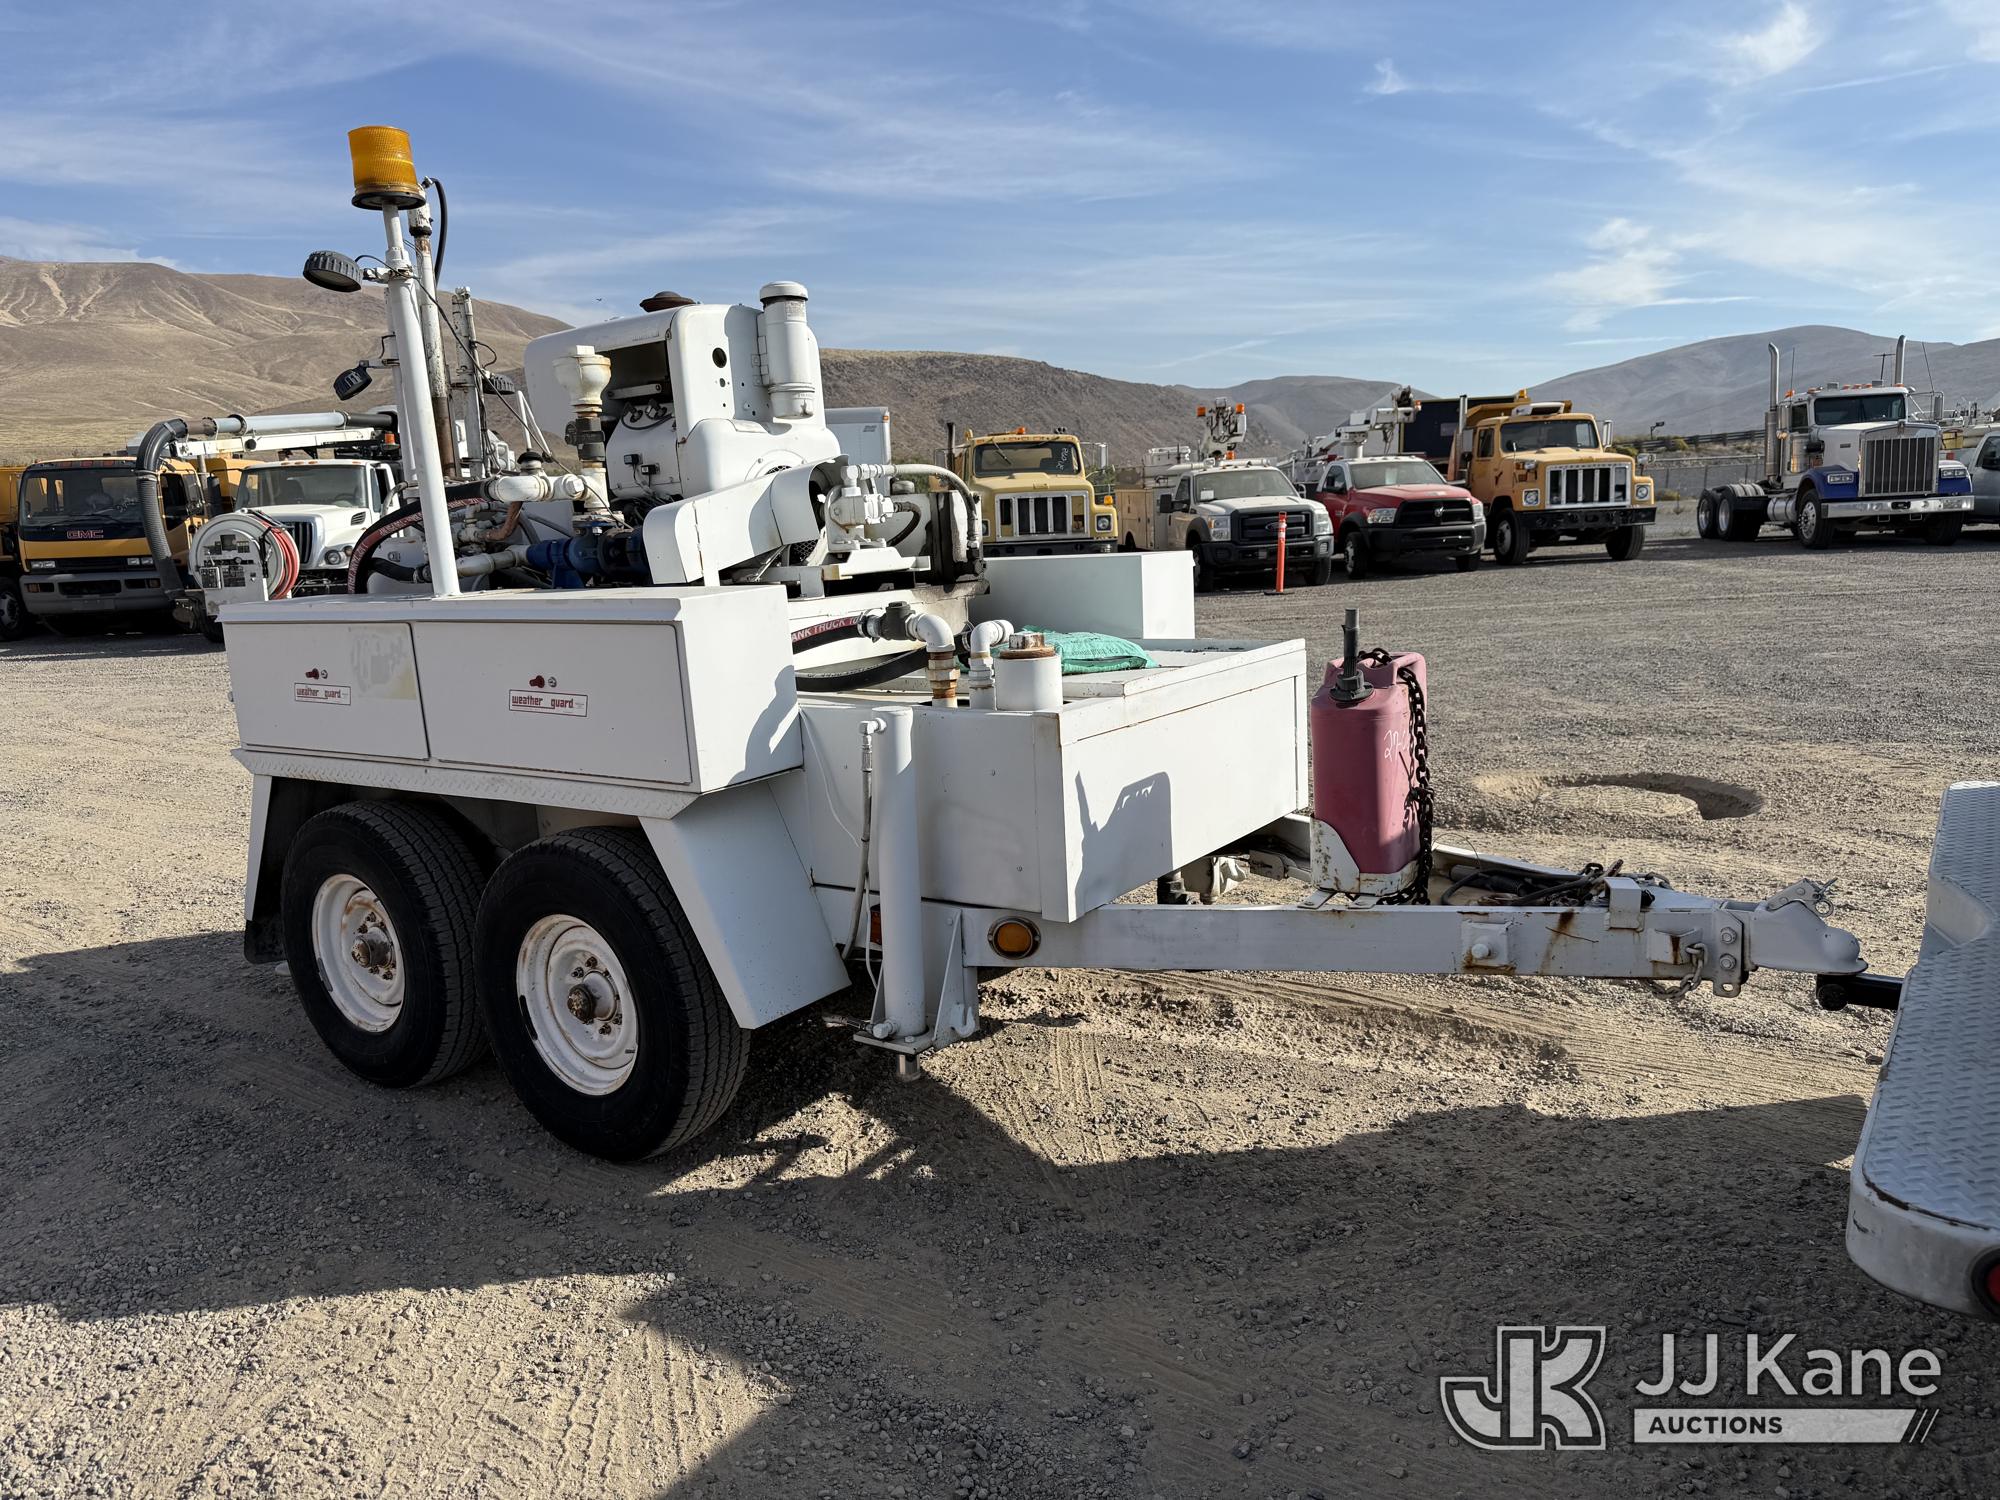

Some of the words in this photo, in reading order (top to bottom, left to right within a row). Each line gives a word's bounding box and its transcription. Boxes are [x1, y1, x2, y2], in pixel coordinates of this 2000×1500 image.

[67, 530, 104, 539] GMC
[791, 628, 812, 642] ANK
[812, 619, 845, 634] TRUCK
[296, 687, 319, 697] weather
[324, 690, 341, 699] guard
[512, 695, 543, 705] weather
[550, 698, 573, 709] guard
